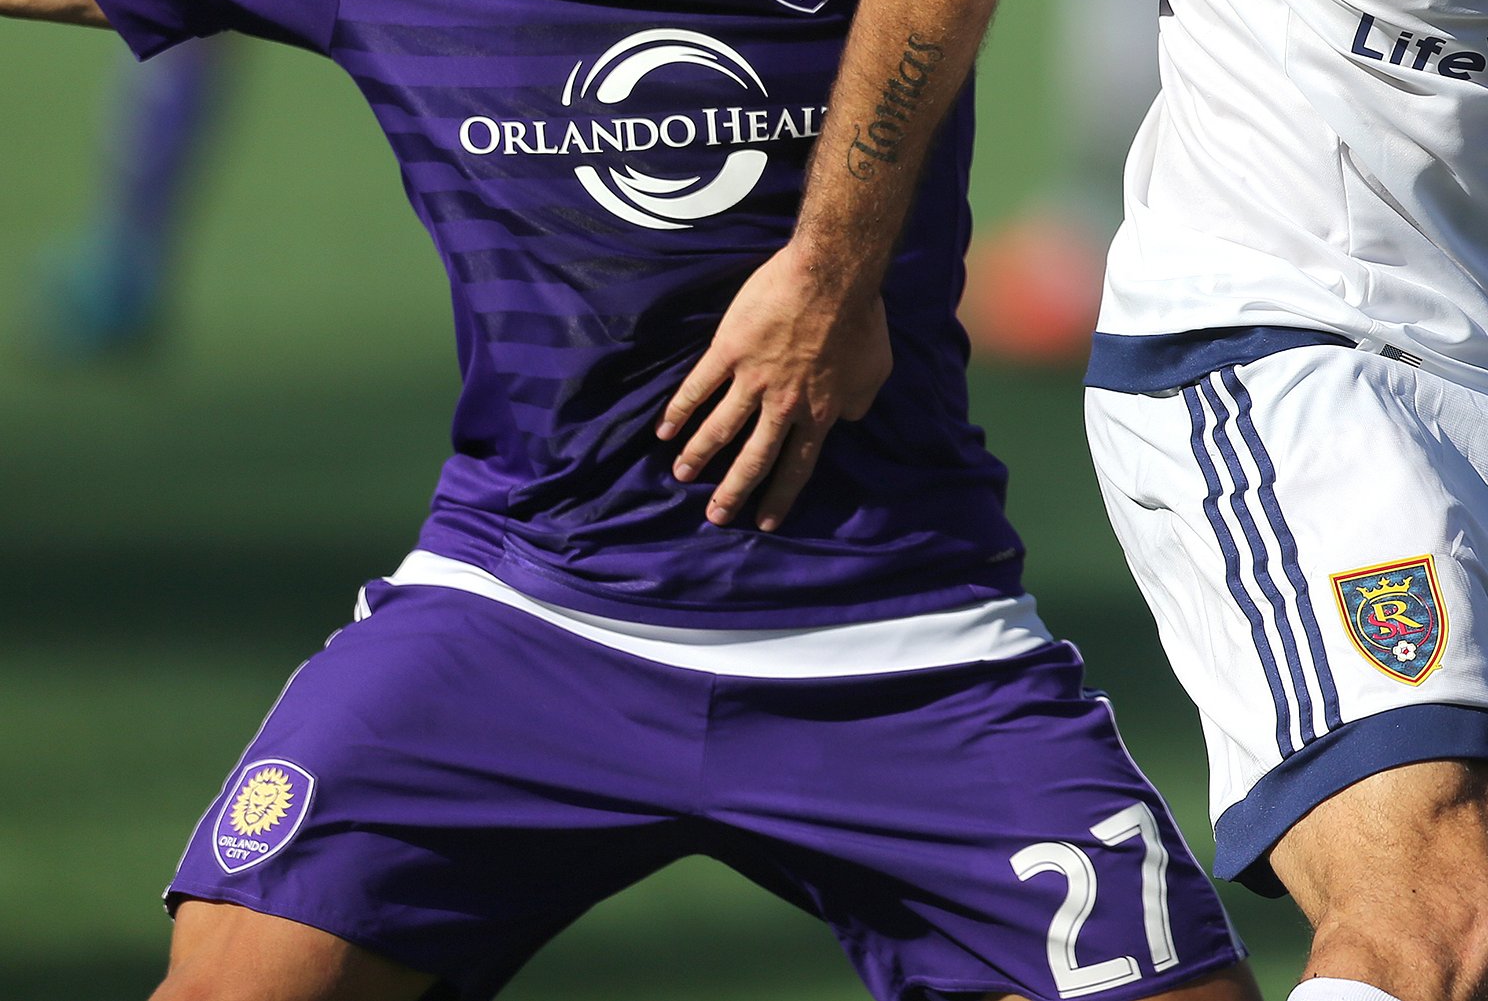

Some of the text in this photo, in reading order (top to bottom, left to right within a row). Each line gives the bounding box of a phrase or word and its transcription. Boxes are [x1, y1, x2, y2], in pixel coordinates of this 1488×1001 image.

[458, 106, 828, 156] ORLANDO HEAL
[847, 32, 944, 181] Tomas
[218, 835, 270, 854] ORLANDO
[225, 847, 251, 861] CITY
[1008, 800, 1180, 999] 27
